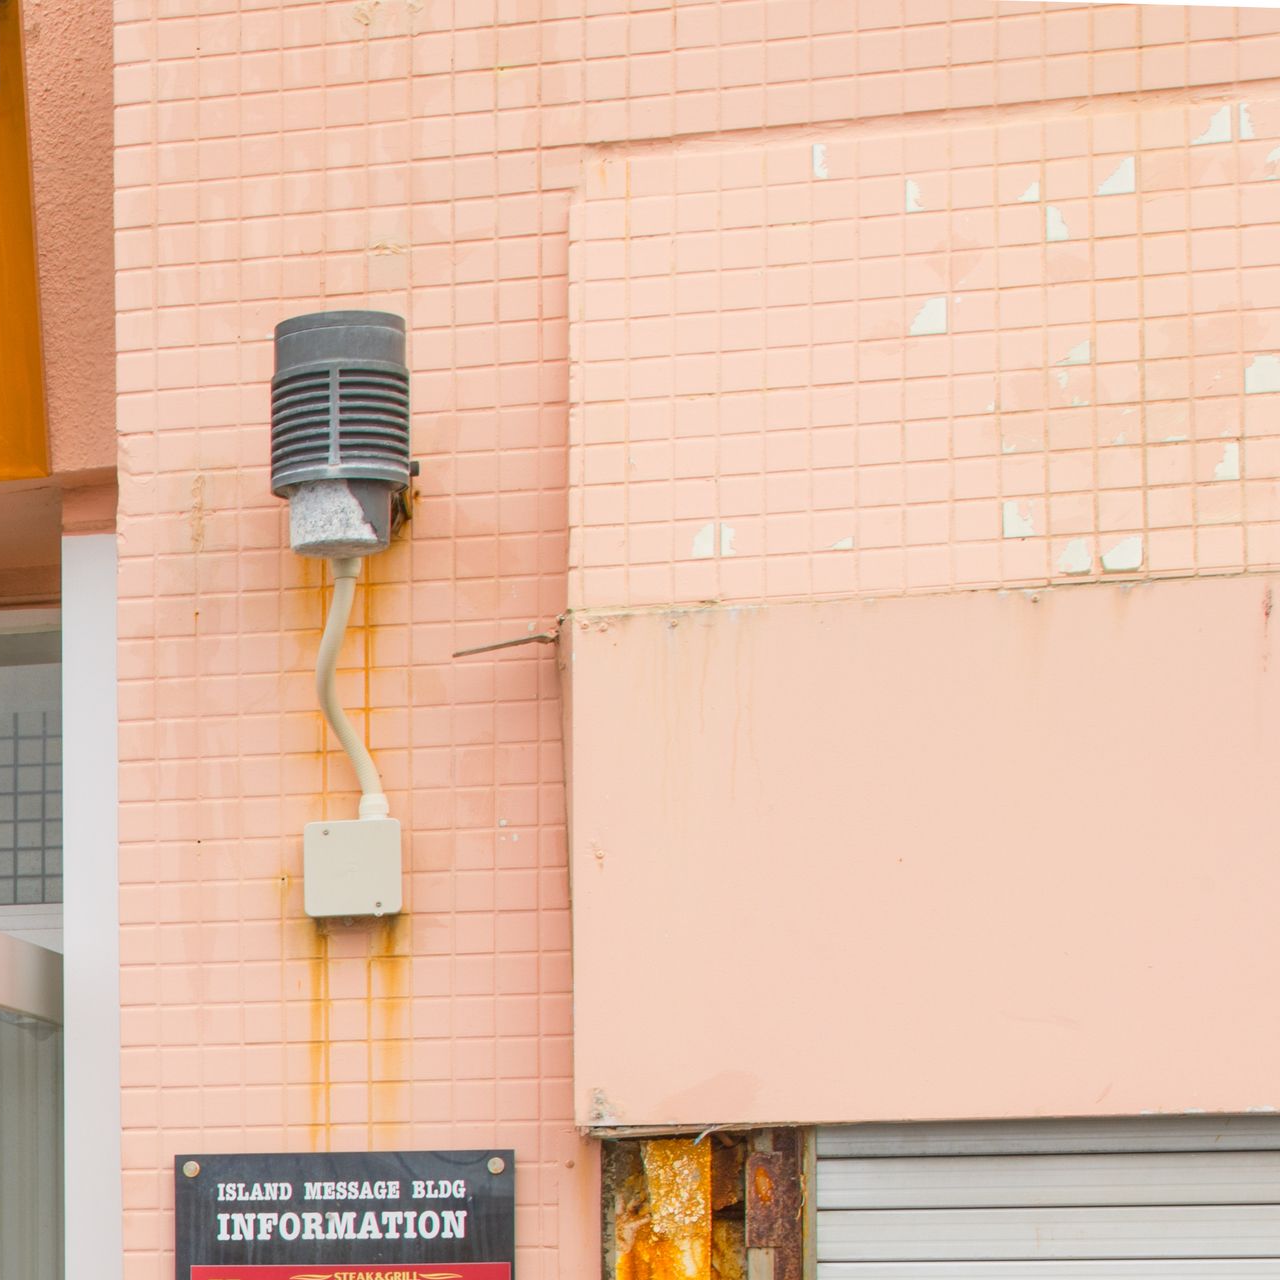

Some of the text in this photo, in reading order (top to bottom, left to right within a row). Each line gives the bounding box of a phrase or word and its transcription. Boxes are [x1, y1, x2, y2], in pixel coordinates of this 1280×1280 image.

[217, 1180, 467, 1201] ISLAND MESSAGE BLDG
[216, 1210, 468, 1241] INFORMATION
